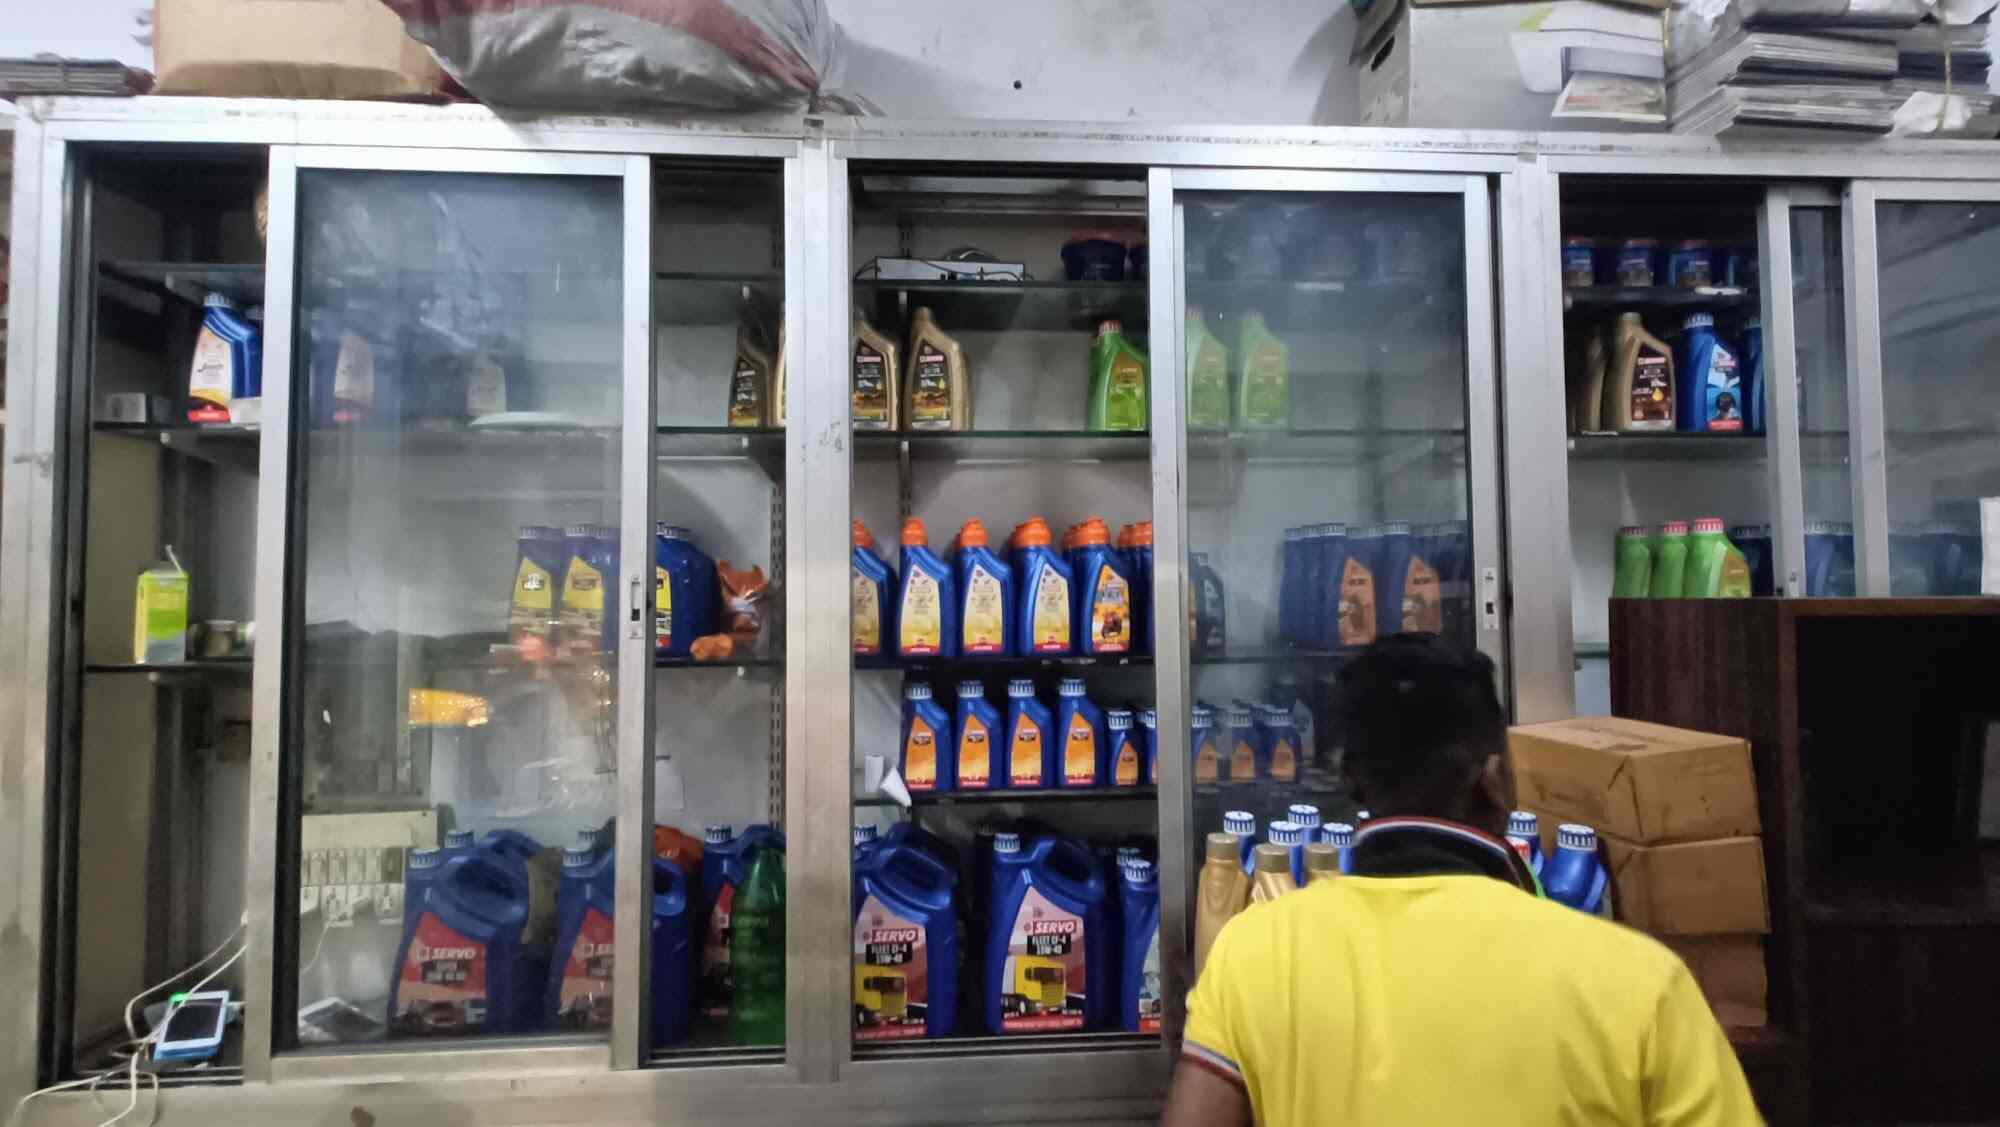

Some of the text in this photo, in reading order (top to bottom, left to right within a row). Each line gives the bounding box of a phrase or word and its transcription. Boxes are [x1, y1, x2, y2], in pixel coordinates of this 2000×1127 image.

[1034, 921, 1075, 934] SERVO
[873, 930, 916, 942] SERVO
[431, 946, 476, 959] SERVO
